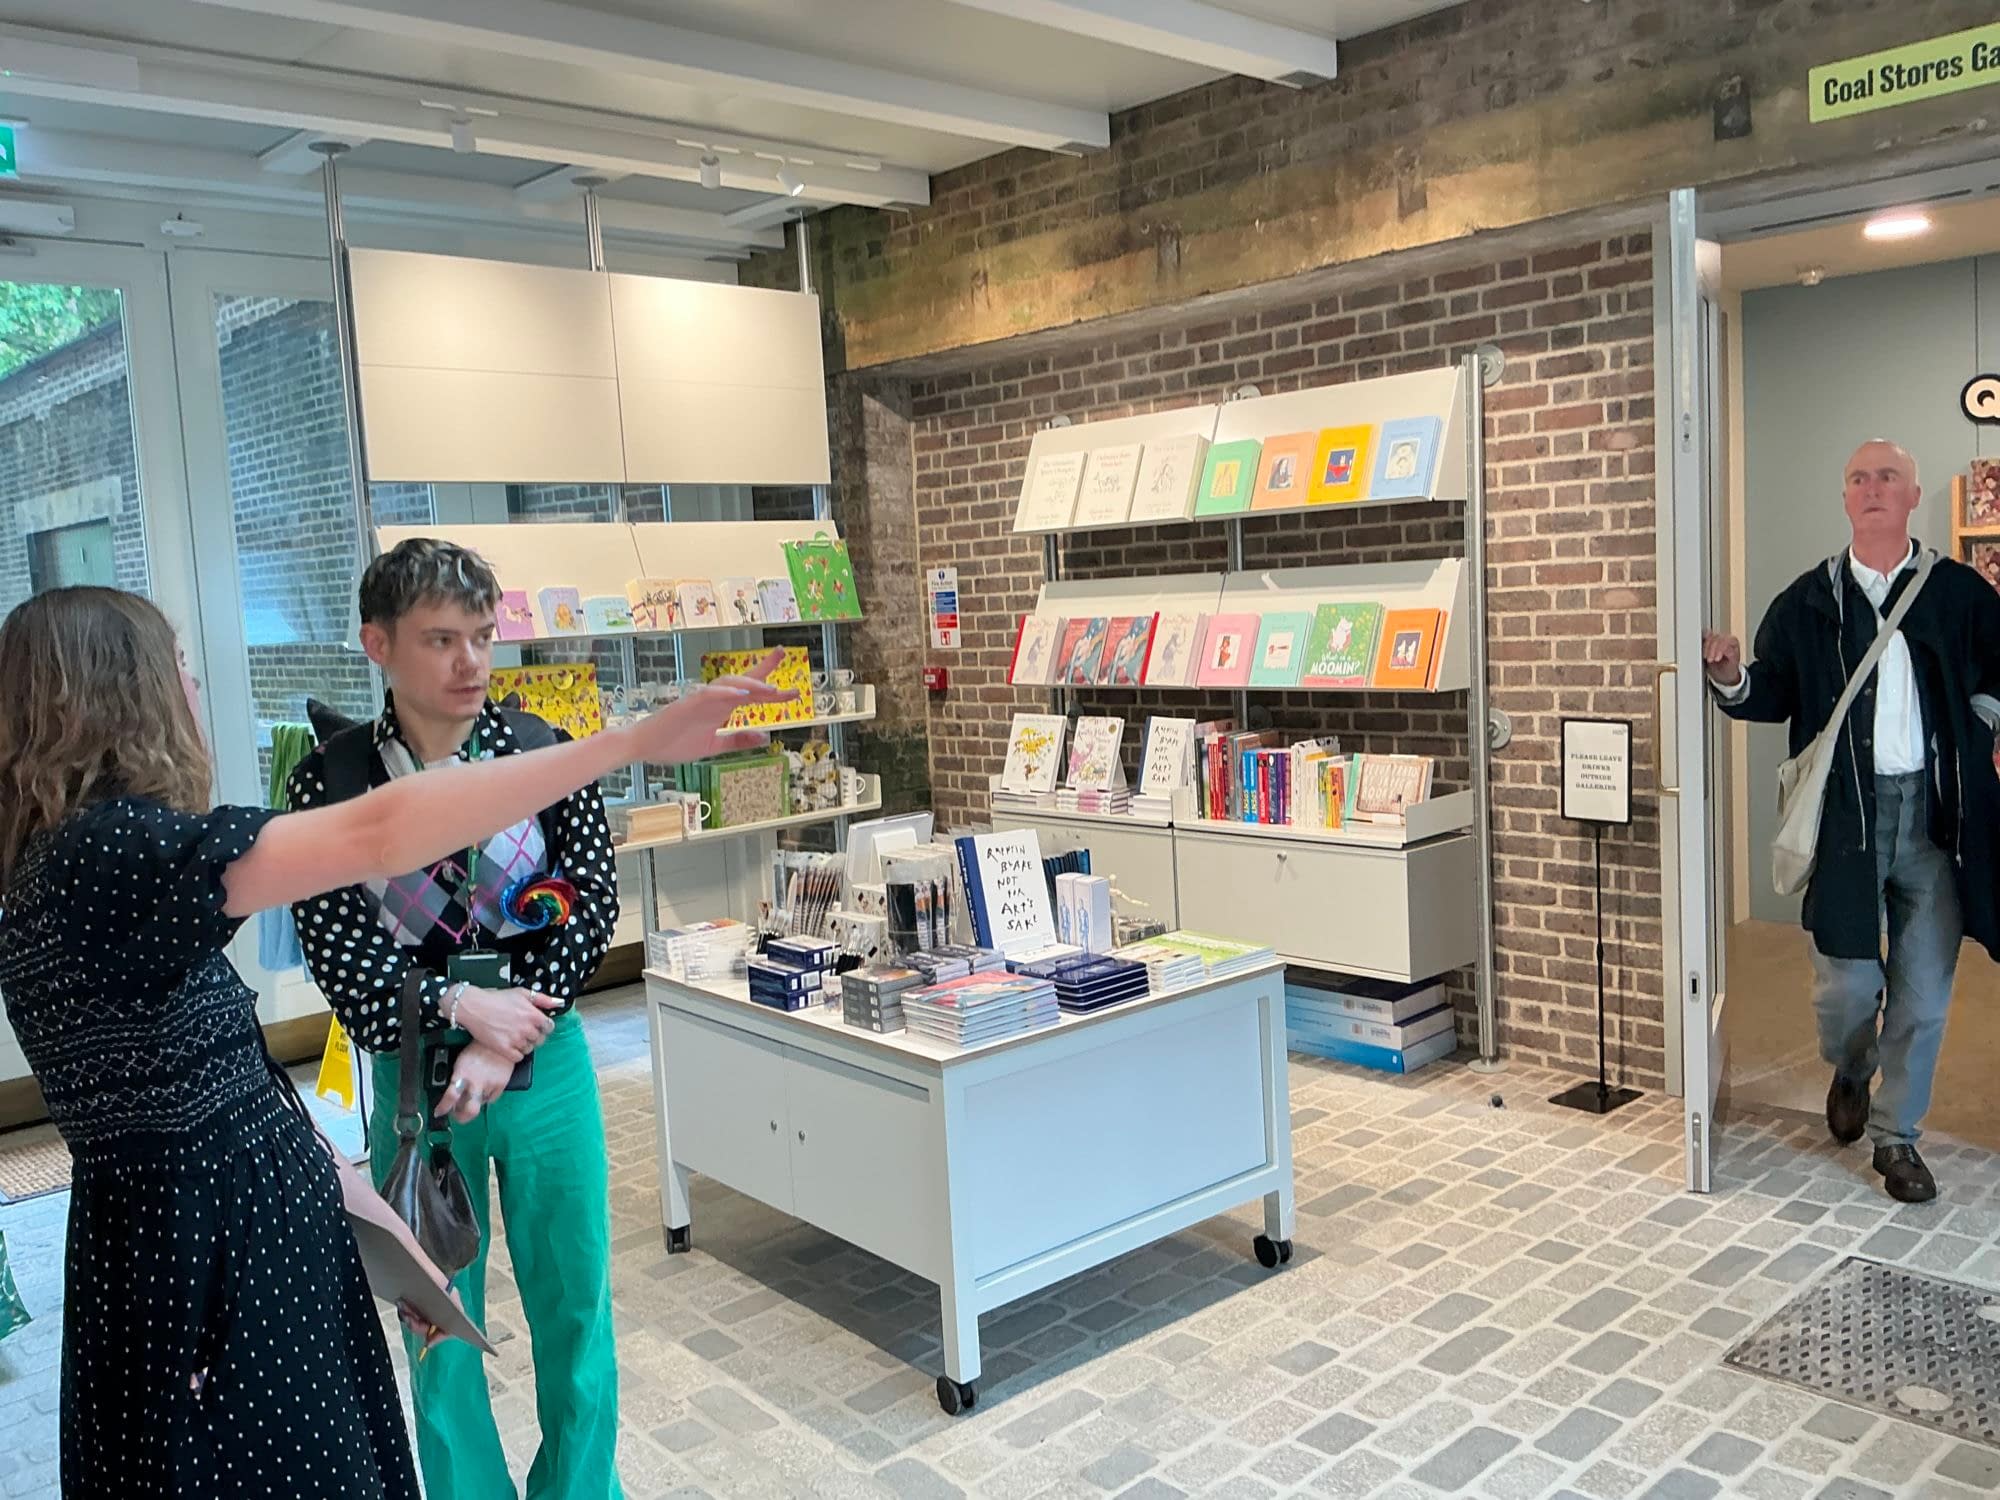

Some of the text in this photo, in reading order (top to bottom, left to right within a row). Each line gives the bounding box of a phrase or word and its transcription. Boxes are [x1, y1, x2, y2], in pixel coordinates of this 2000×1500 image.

[1824, 70, 1873, 106] Coal
[1880, 56, 1963, 93] Stores
[1311, 661, 1360, 675] MOOMIN?
[1571, 753, 1598, 761] PLEASE
[1581, 773, 1612, 781] OUTSIDE
[1576, 783, 1616, 791] GALLERIES
[1001, 860, 1032, 873] BLAKE
[997, 876, 1018, 890] NOT
[1008, 888, 1025, 899] FOR
[1007, 914, 1038, 931] SAKE
